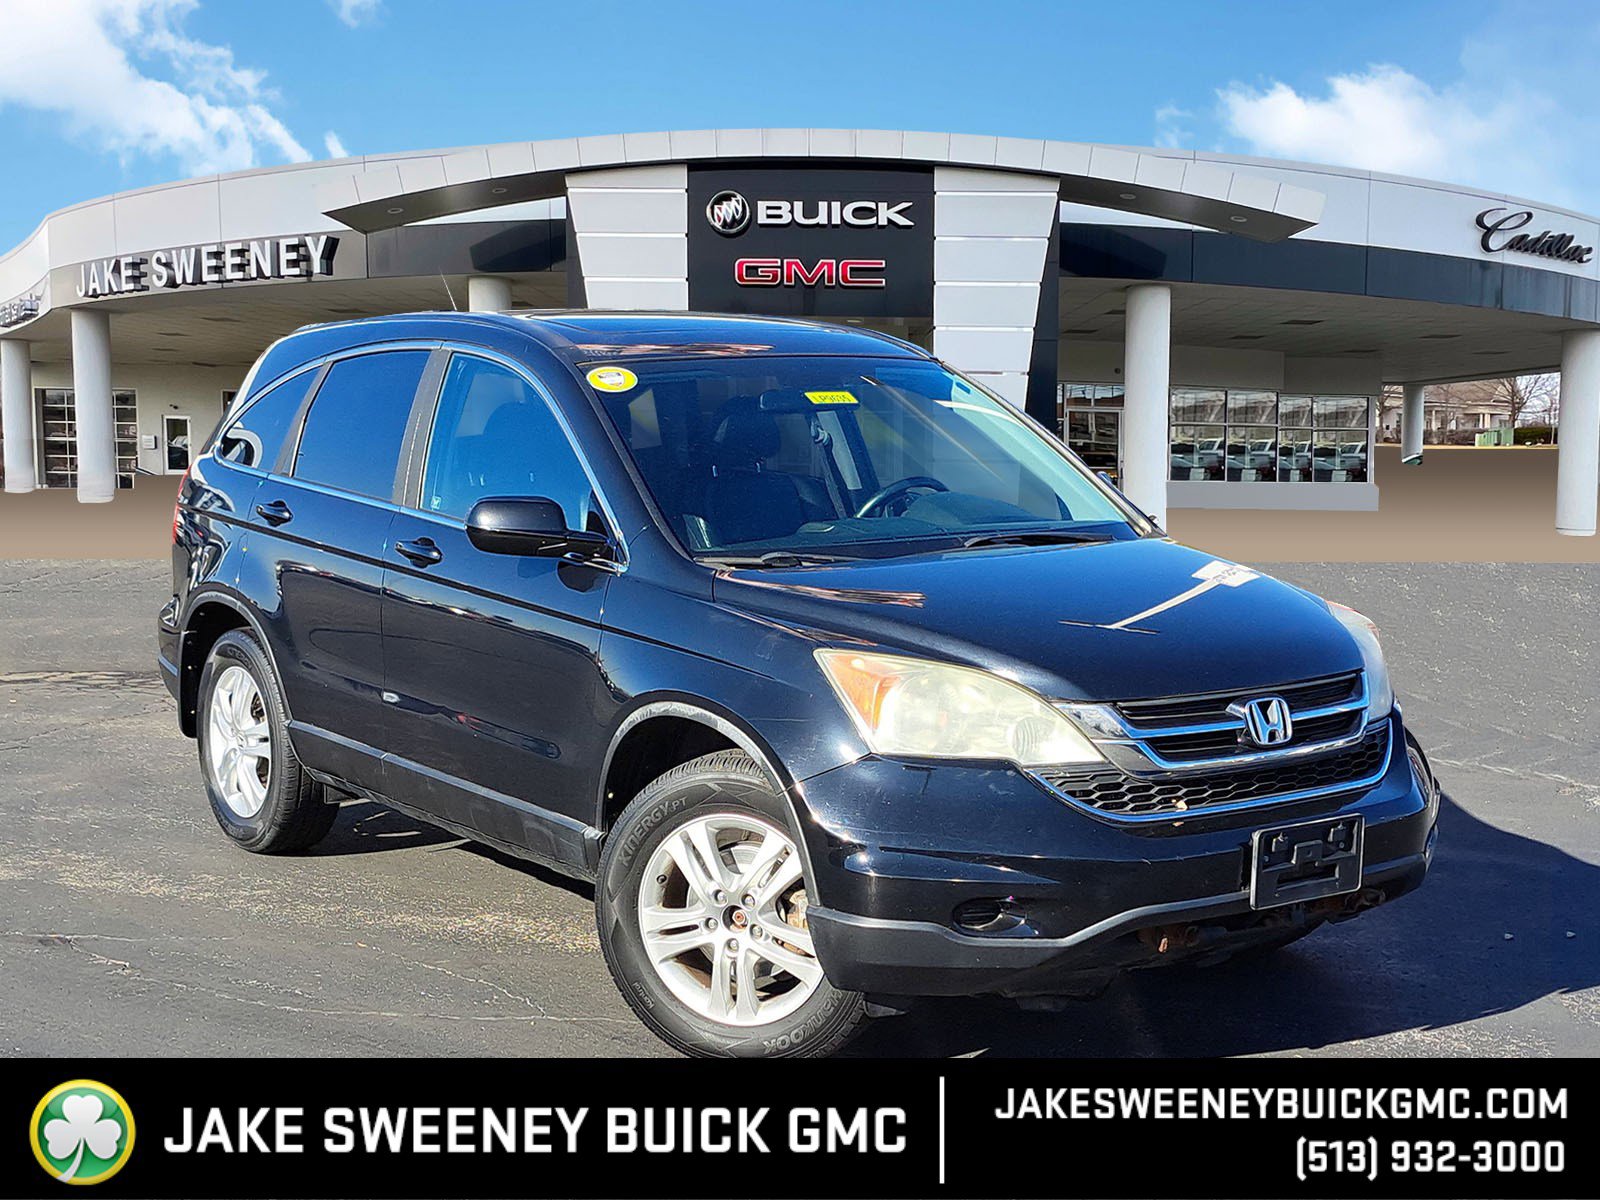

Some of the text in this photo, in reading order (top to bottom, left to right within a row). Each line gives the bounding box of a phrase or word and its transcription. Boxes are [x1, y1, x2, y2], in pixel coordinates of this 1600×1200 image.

[757, 200, 915, 226] BUICK
[1475, 207, 1593, 263] Cadillac
[76, 234, 334, 298] JAKE SWEENEY
[735, 258, 886, 287] GMC
